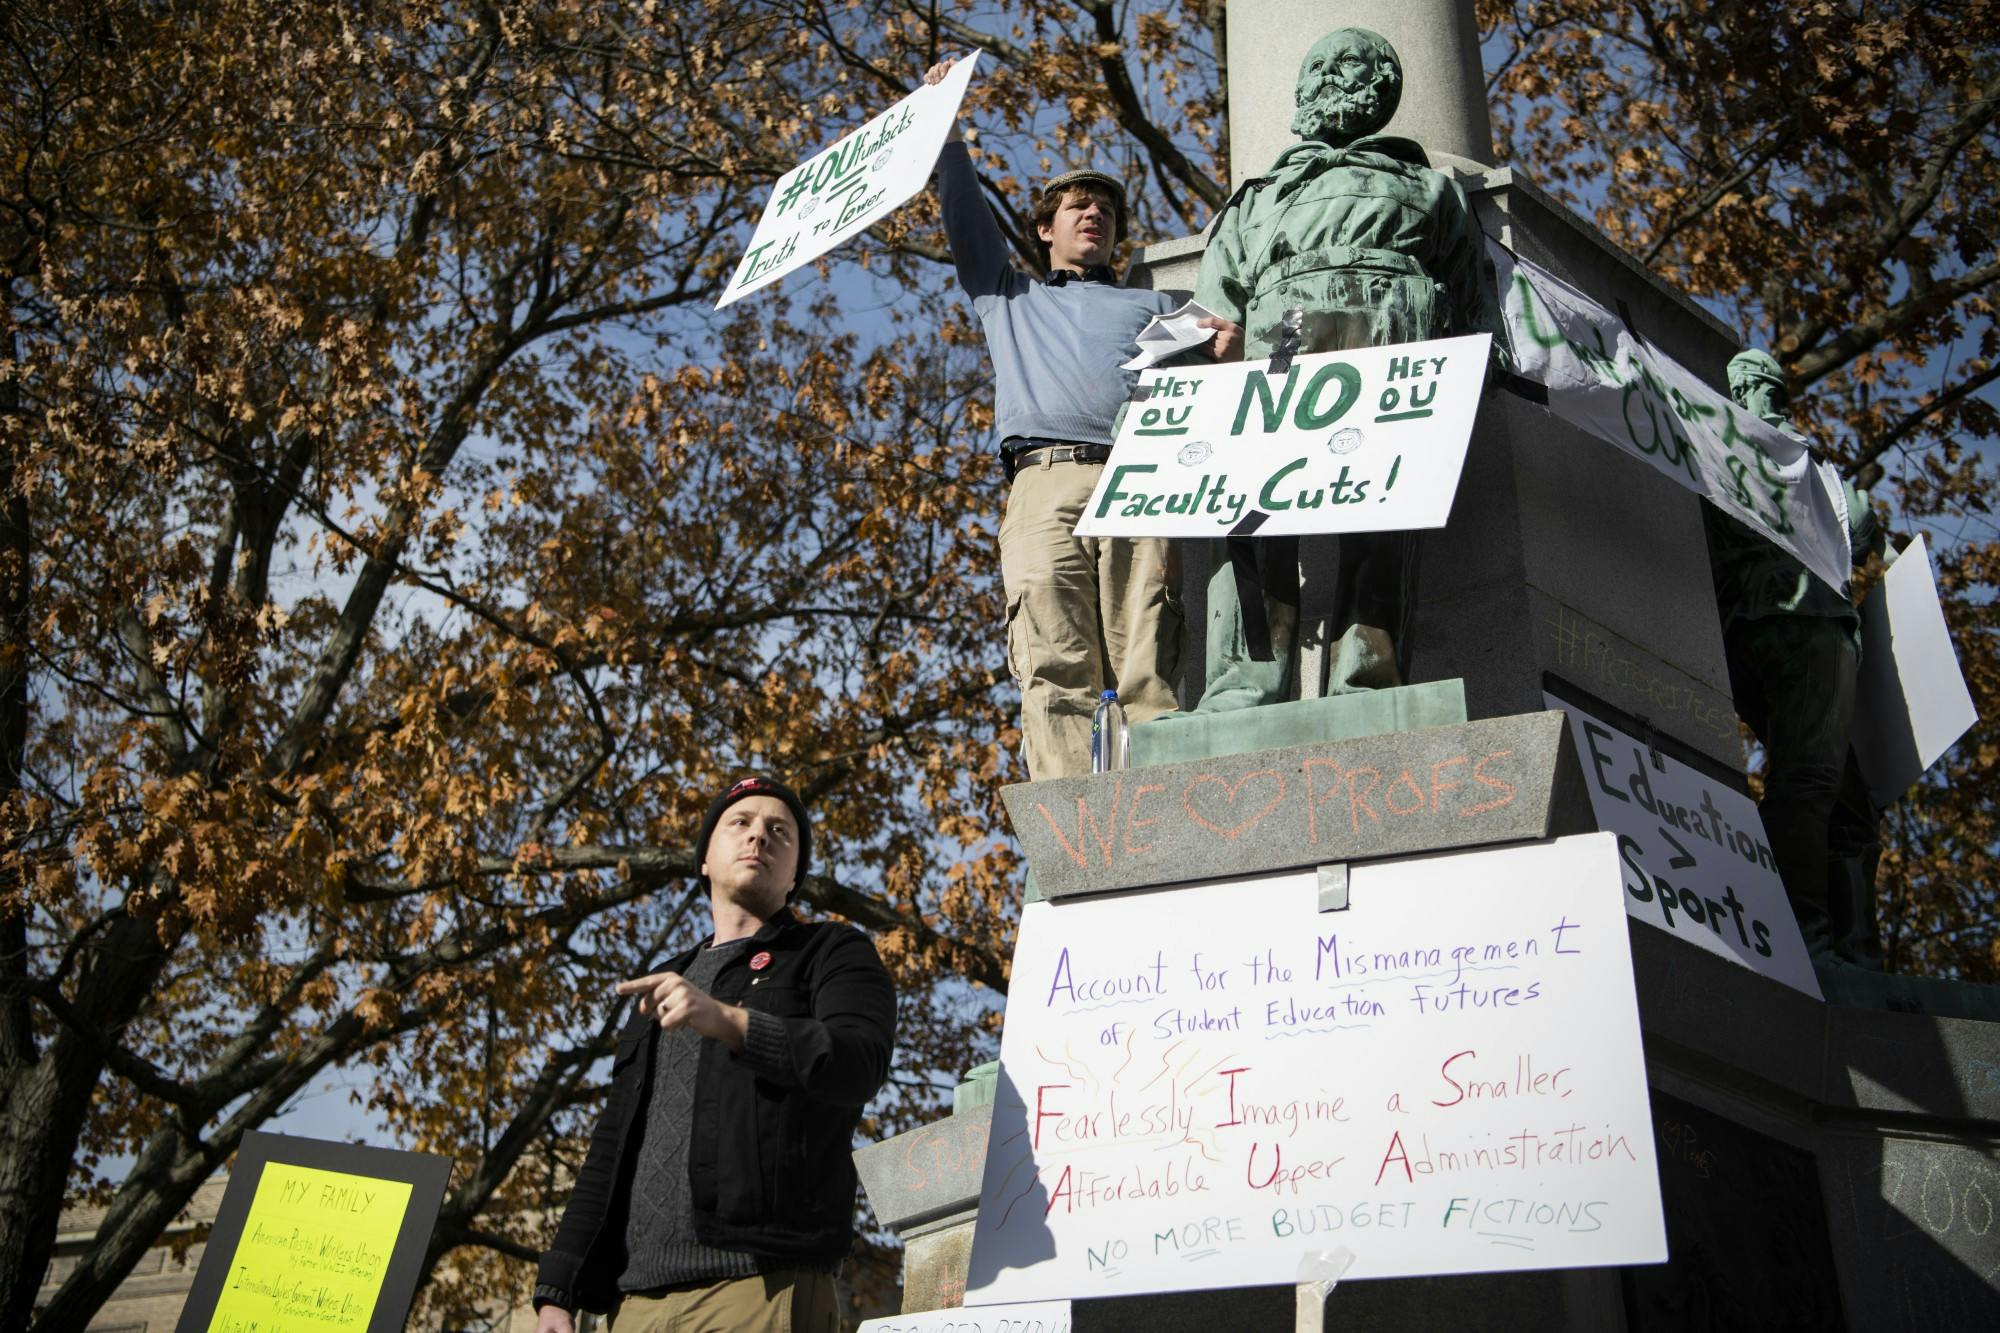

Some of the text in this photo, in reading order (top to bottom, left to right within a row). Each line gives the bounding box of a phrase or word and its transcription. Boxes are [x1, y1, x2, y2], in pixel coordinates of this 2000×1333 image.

[741, 232, 801, 284] Truth
[834, 183, 887, 230] Power
[1151, 377, 1203, 398] HEY
[1230, 362, 1361, 436] NO
[1379, 382, 1437, 411] OU
[1387, 356, 1448, 382] HEY
[1140, 406, 1193, 425] OU
[1095, 464, 1247, 524] Faculty
[1038, 781, 1166, 869] WE
[1583, 720, 1777, 873] Education
[1618, 833, 1772, 958] Sports
[1048, 946, 1169, 1007] Account
[1190, 952, 1229, 991] for
[1242, 948, 1292, 986] the
[1100, 981, 1541, 1046] of Student Education Futures
[1034, 1078, 1194, 1152] Fearlessly
[1215, 1067, 1351, 1137] Imagine
[1387, 1093, 1409, 1114] a
[280, 1180, 376, 1214] MY FAMILY
[1045, 1155, 1209, 1217] Affordable
[1248, 1142, 1345, 1196] Upper
[1375, 1122, 1636, 1186] Administration
[1088, 1198, 1608, 1271] NO MORE BUDGET FICTIONS
